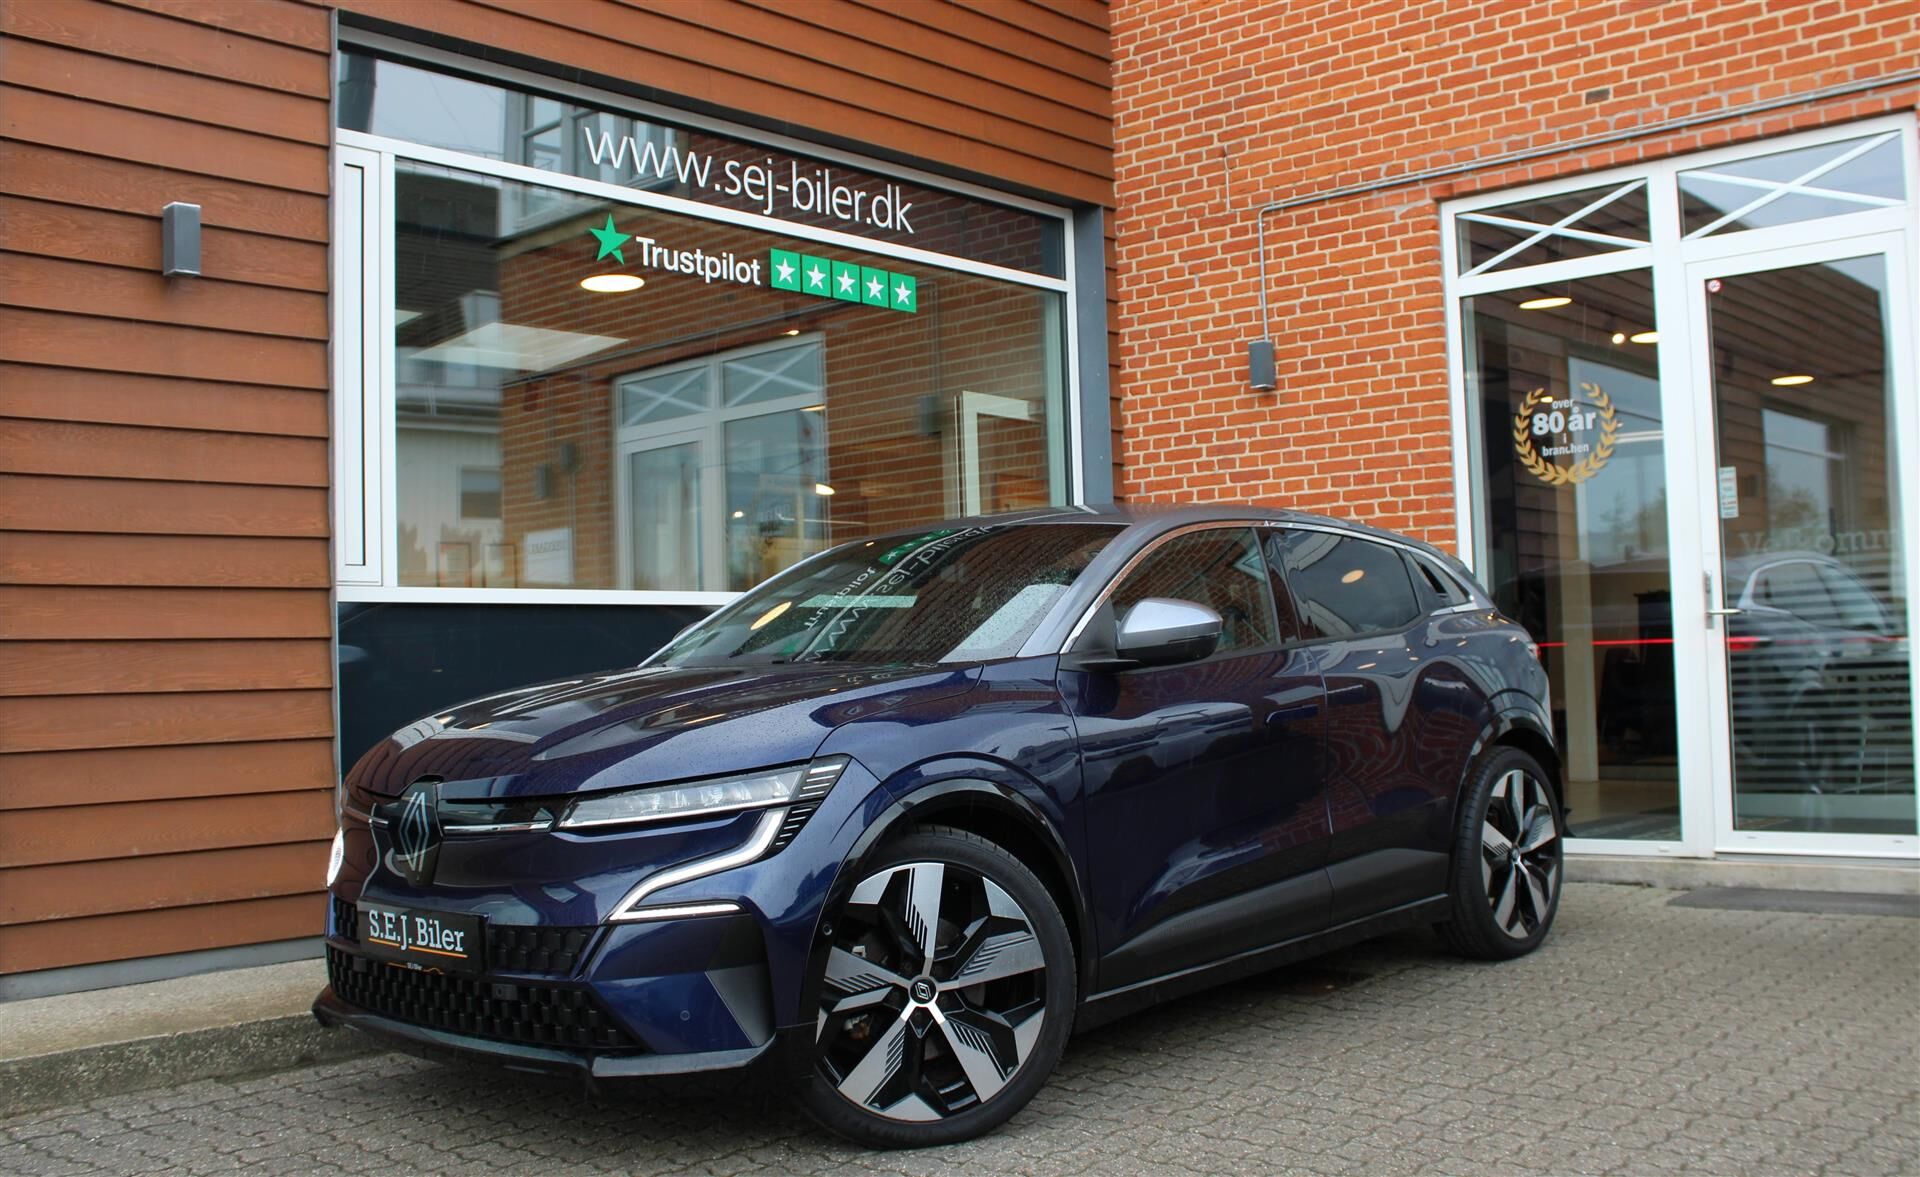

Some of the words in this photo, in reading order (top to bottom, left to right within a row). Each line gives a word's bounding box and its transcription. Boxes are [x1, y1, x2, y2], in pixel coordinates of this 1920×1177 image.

[584, 127, 914, 234] www.sej-biler.dk
[636, 236, 761, 286] Trustpilot
[1532, 411, 1565, 435] 80
[1568, 406, 1596, 431] år
[1552, 398, 1575, 409] over
[1542, 443, 1589, 457] branchen
[369, 909, 413, 950] S.E.J.
[416, 917, 465, 952] Biler
